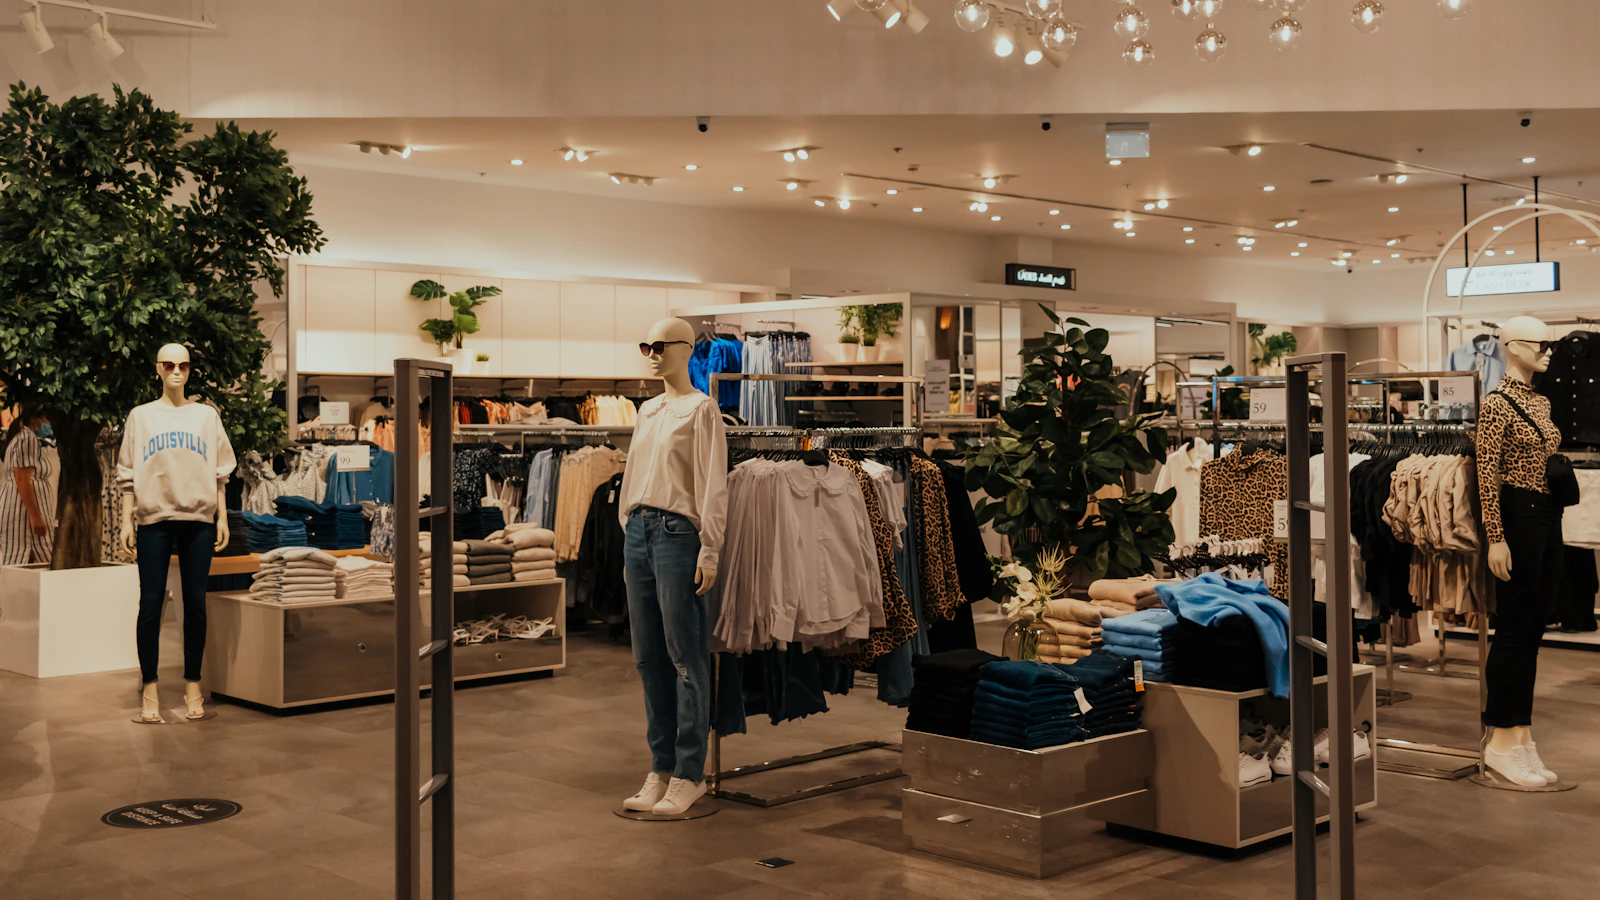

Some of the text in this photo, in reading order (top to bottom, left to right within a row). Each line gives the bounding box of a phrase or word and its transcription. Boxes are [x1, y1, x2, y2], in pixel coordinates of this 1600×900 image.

[1475, 280, 1532, 291] CASH DESK
[1442, 387, 1454, 396] 85
[1253, 403, 1266, 414] 59
[143, 431, 207, 462] LOUISVILLE
[340, 456, 351, 465] 99
[1278, 518, 1288, 531] 5
